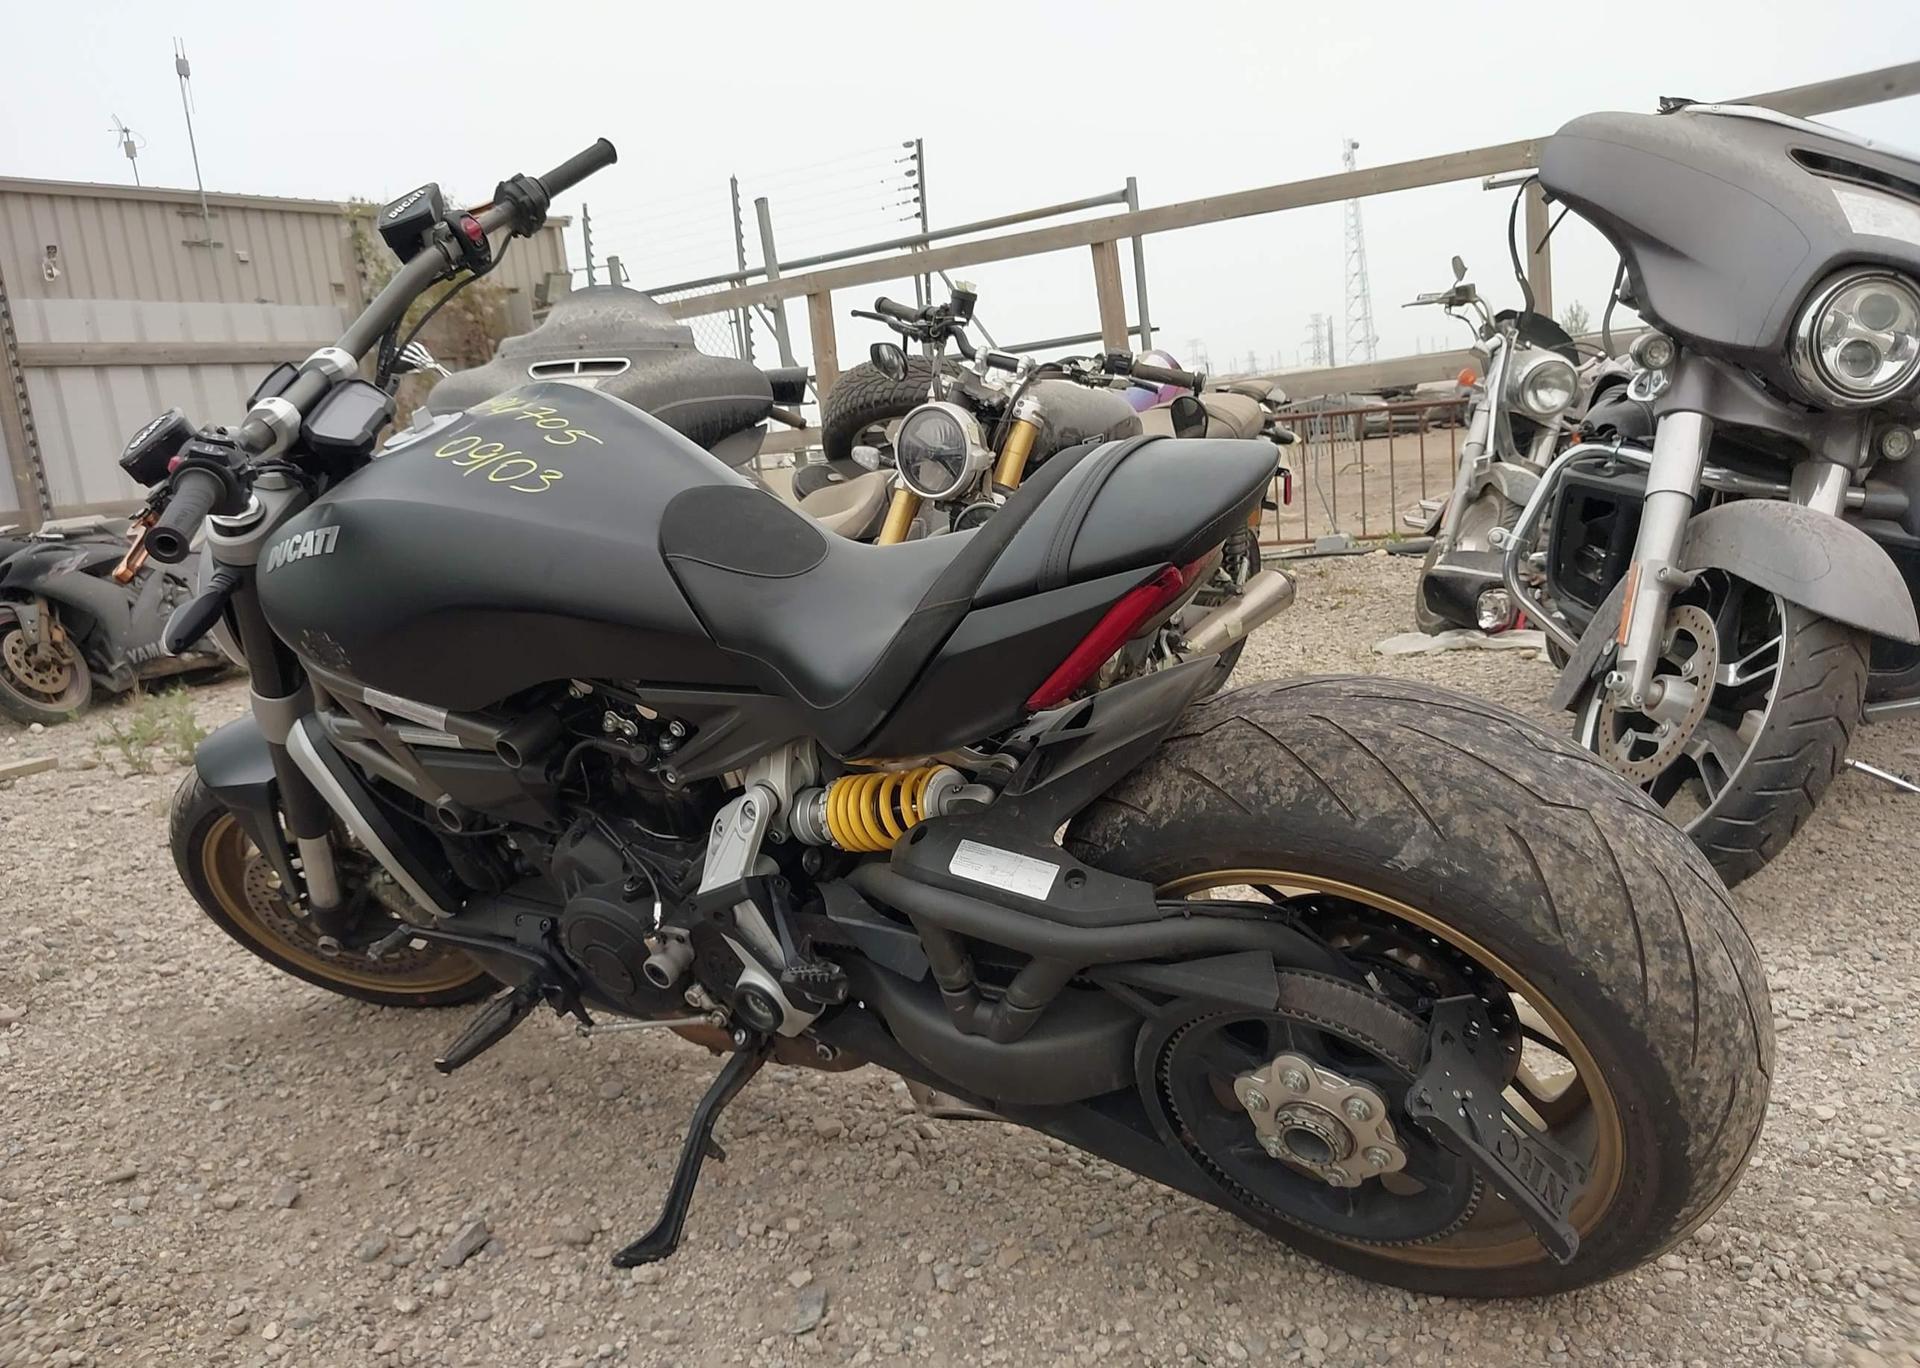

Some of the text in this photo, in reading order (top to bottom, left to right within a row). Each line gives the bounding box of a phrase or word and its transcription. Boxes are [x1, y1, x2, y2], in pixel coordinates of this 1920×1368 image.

[388, 189, 426, 219] DUCATI
[434, 436, 564, 493] 09/03
[266, 525, 341, 574] DUCATI
